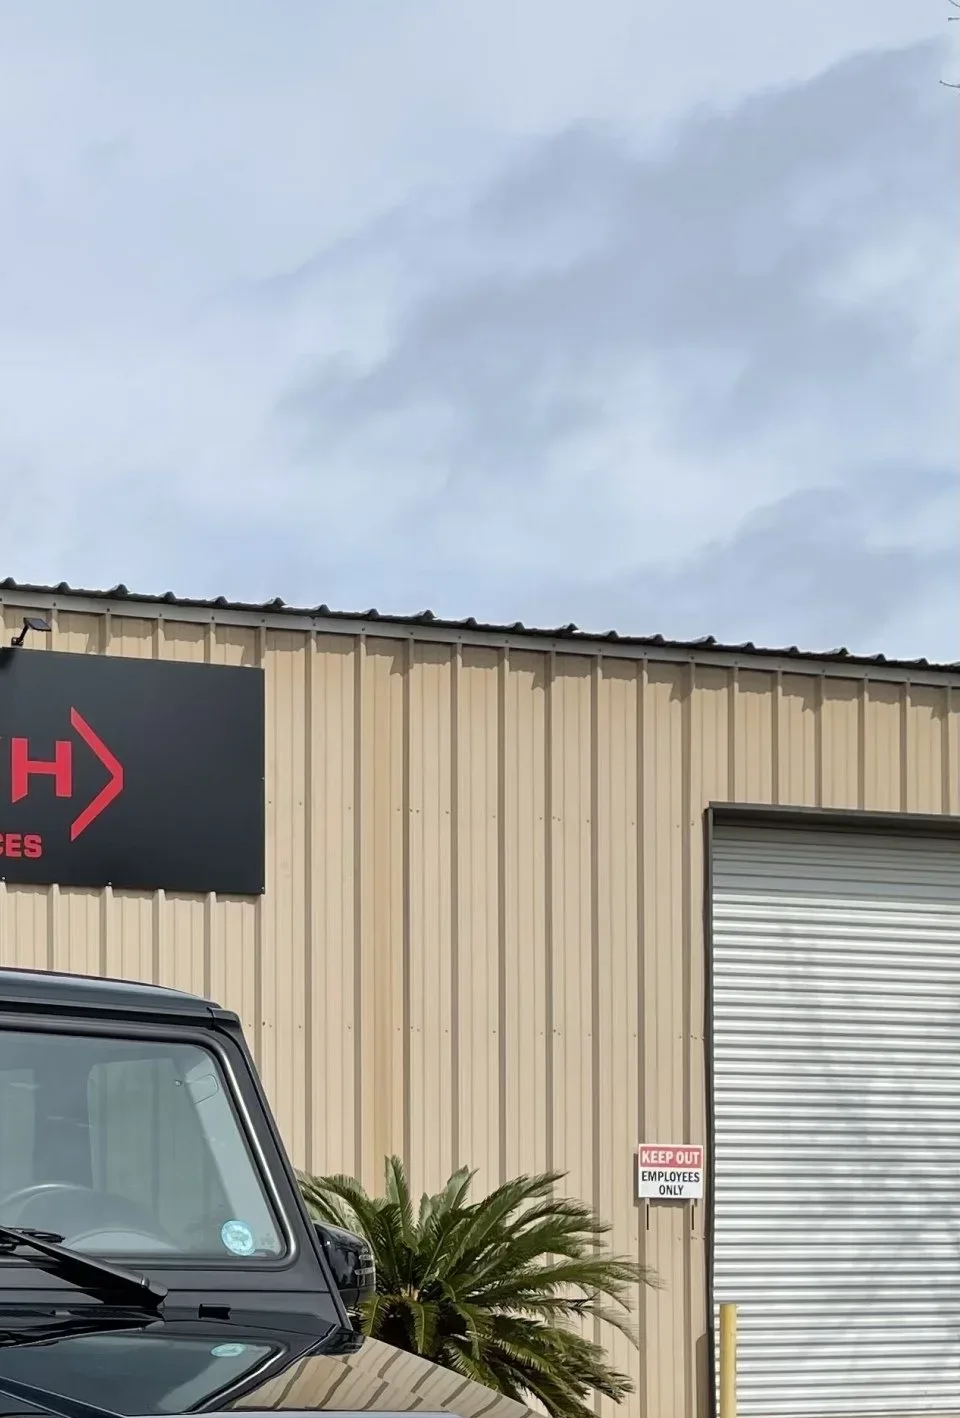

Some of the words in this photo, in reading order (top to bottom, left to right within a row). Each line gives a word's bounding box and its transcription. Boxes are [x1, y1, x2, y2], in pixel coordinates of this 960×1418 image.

[641, 1150, 674, 1164] KEEP
[675, 1151, 700, 1165] OUT
[641, 1171, 700, 1182] EMPLOYEES
[658, 1184, 684, 1195] ONLY
